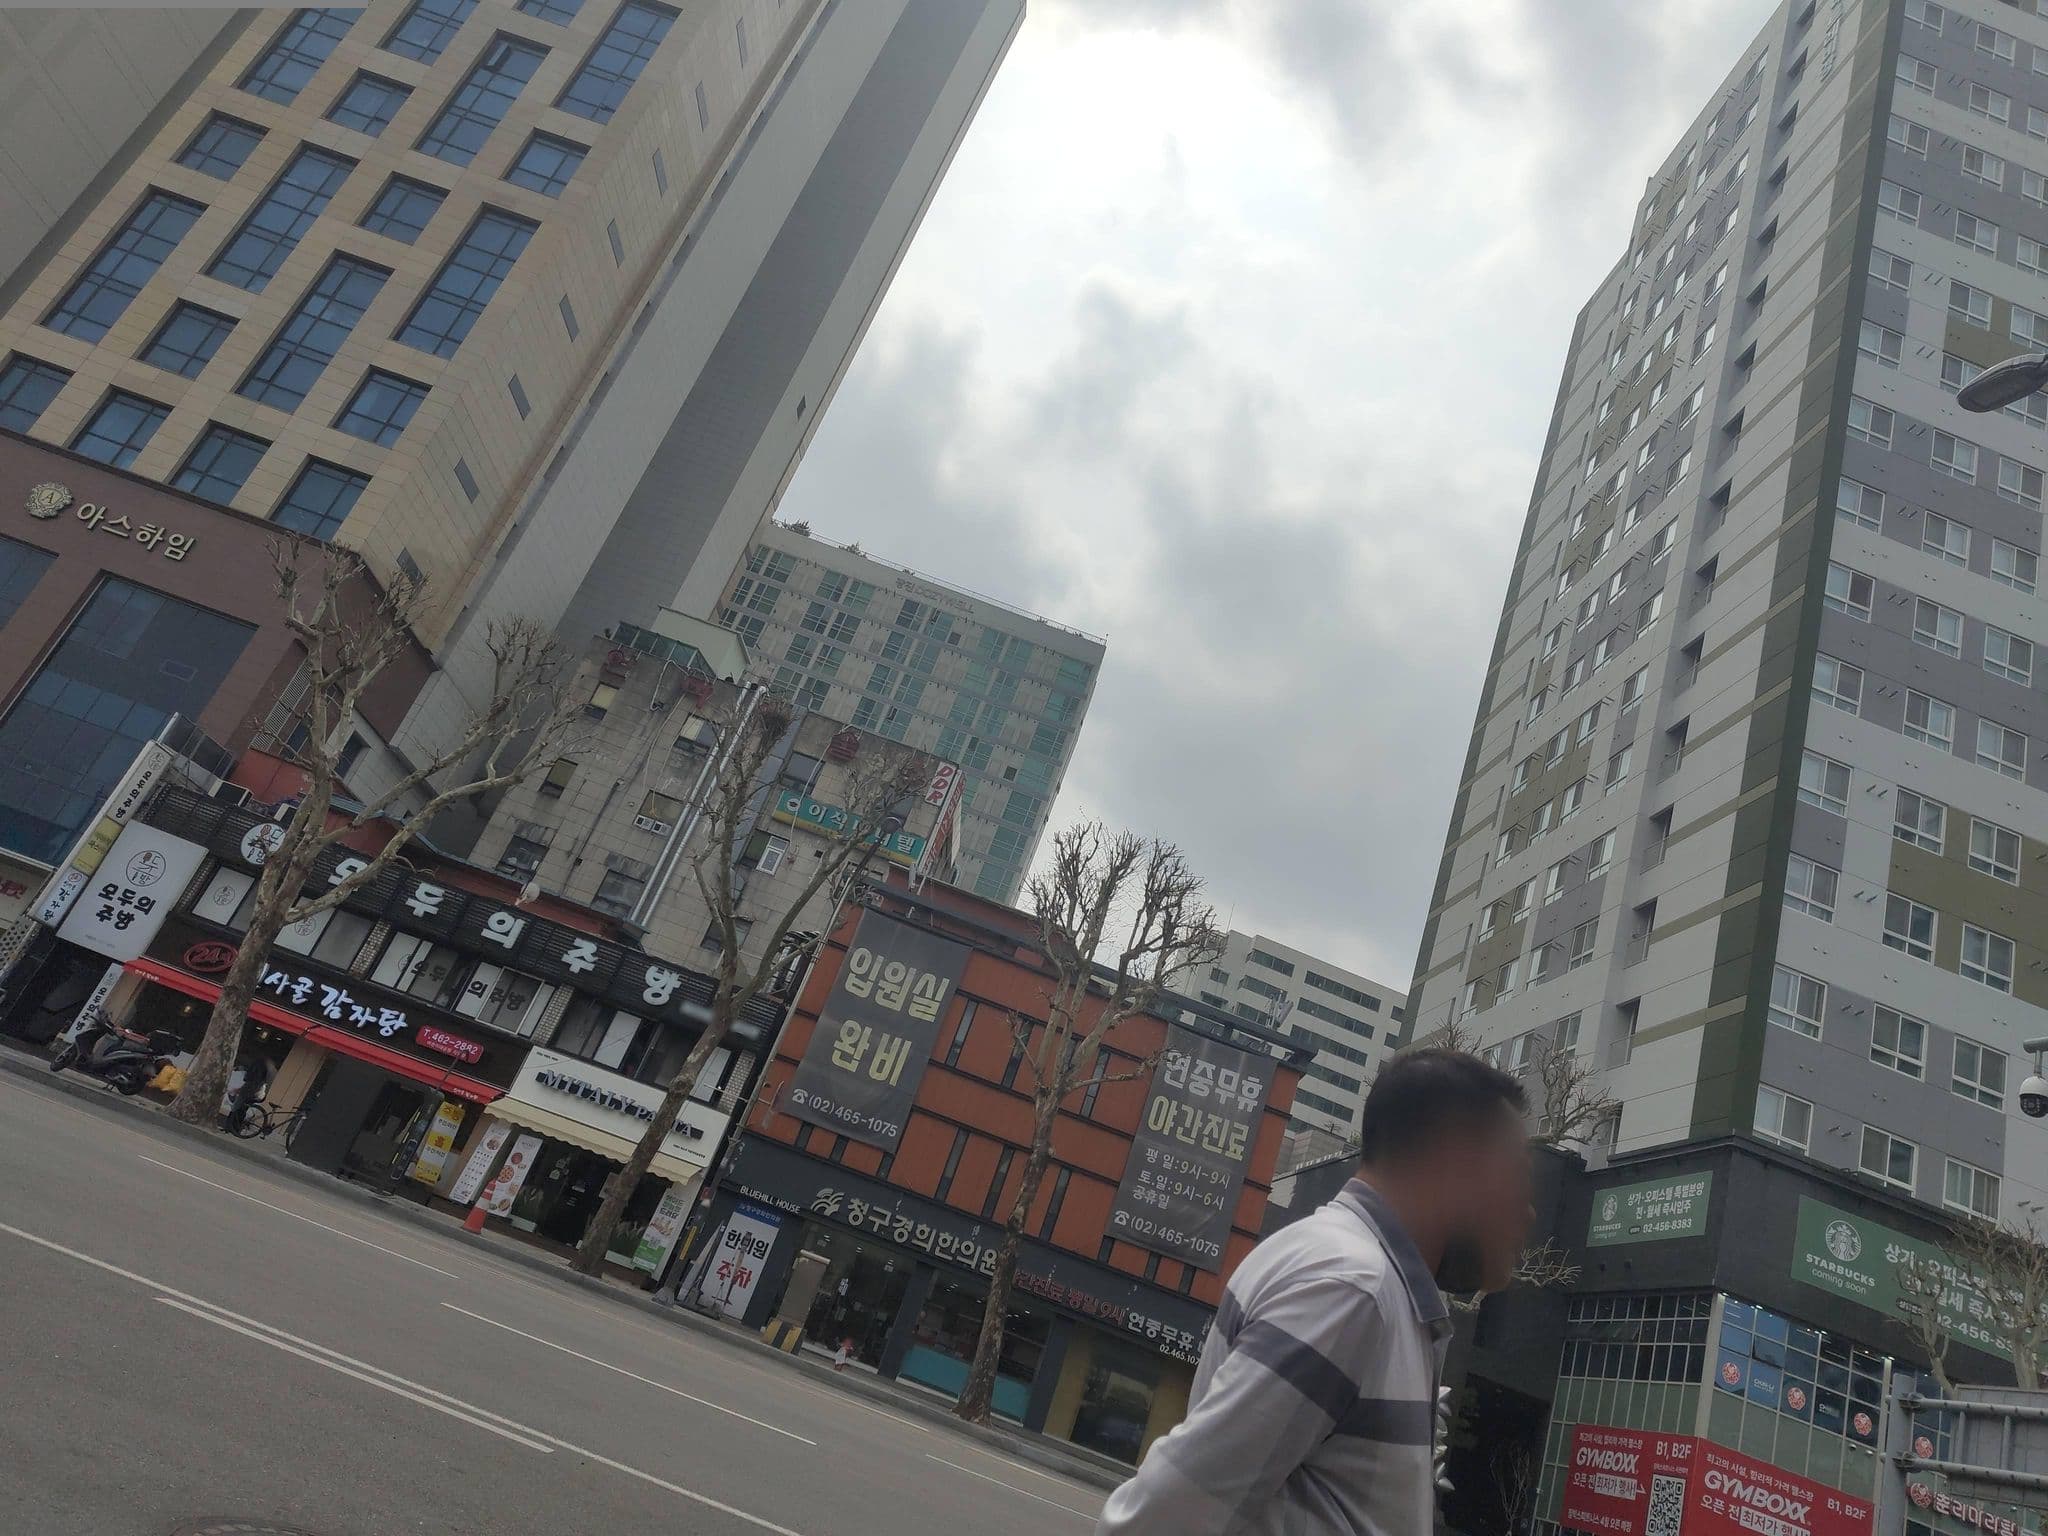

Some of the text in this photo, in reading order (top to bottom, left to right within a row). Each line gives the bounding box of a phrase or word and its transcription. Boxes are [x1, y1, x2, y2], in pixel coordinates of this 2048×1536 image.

[77, 502, 196, 560] 아스하임
[96, 904, 135, 930] 주방
[98, 882, 156, 915] 모두의
[845, 947, 950, 1022] 입원실
[320, 984, 408, 1037] 감자탕
[831, 1019, 912, 1087] 완비
[1165, 1049, 1263, 1113] 연중무휴
[634, 1104, 694, 1139] PATA
[809, 1094, 898, 1137] (02)465-1075
[1147, 1095, 1250, 1161] 야간진료
[740, 1185, 801, 1214] BLUEHILL HOUSE
[1132, 1185, 1170, 1210] 공휴일
[848, 1198, 999, 1278] 청구경희한의원
[1130, 1215, 1220, 1257] (02)465-1075
[1805, 1252, 1876, 1288] STARBUCKS
[1811, 1267, 1867, 1296] coming soon
[1128, 1311, 1195, 1352] 연중무휴
[1159, 1343, 1201, 1368] 02.465.107
[1576, 1446, 1640, 1475] GYMBOXX
[1671, 1442, 1692, 1461] B2F
[1700, 1494, 1725, 1515] 오픈
[1728, 1503, 1741, 1521] 전
[1742, 1510, 1778, 1534] 최저가
[1704, 1470, 1811, 1524] GYMBOXX
[1845, 1504, 1867, 1520] B2F
